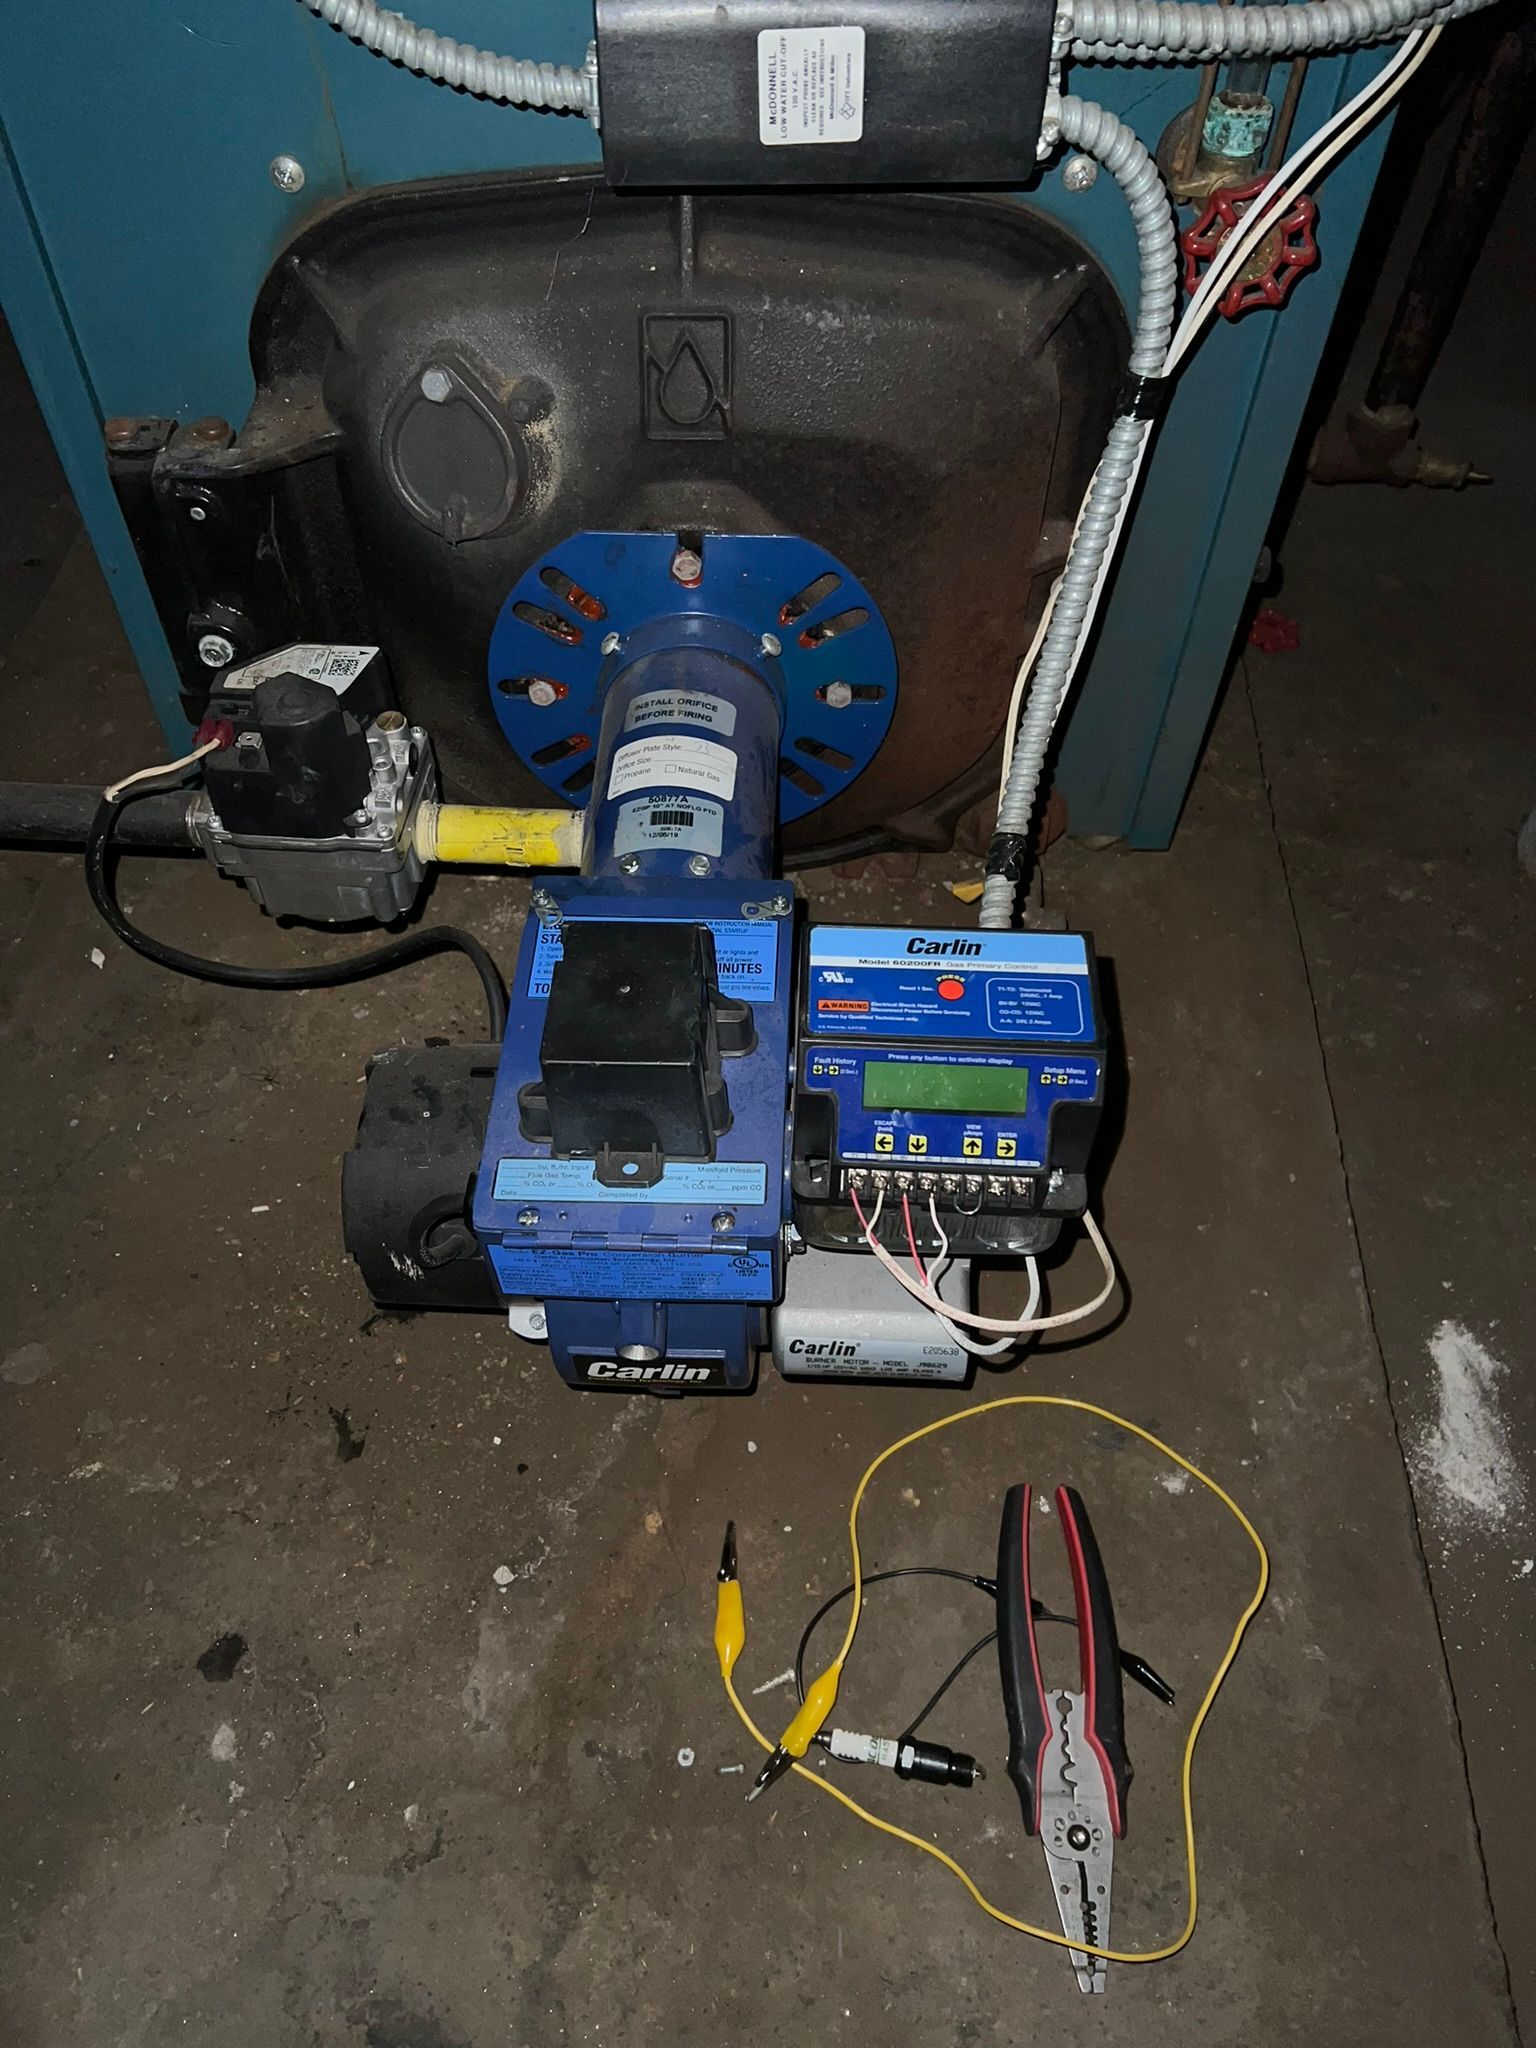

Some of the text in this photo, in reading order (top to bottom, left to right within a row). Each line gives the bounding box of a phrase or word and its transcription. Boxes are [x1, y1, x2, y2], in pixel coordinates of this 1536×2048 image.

[768, 52, 777, 125] McDONNELL
[780, 118, 788, 138] LOW
[634, 698, 718, 712] INSTALL ORIFICE
[635, 710, 713, 722] BEFORE FIRING
[643, 744, 661, 754] Plate
[616, 760, 636, 774] Orifice
[624, 767, 652, 780] Propane
[678, 766, 720, 782] Natural Gas
[702, 808, 717, 816] PTD
[906, 937, 982, 956] Carlin
[967, 962, 1002, 970] Primary
[936, 974, 966, 982] PRESS
[831, 1002, 868, 1010] WARNING
[832, 1058, 857, 1066] History
[1044, 1066, 1064, 1074] Setup
[598, 1191, 638, 1199] Completed
[789, 1339, 857, 1356] Carlin
[922, 1346, 960, 1356] E205638
[588, 1362, 711, 1380] Carlin
